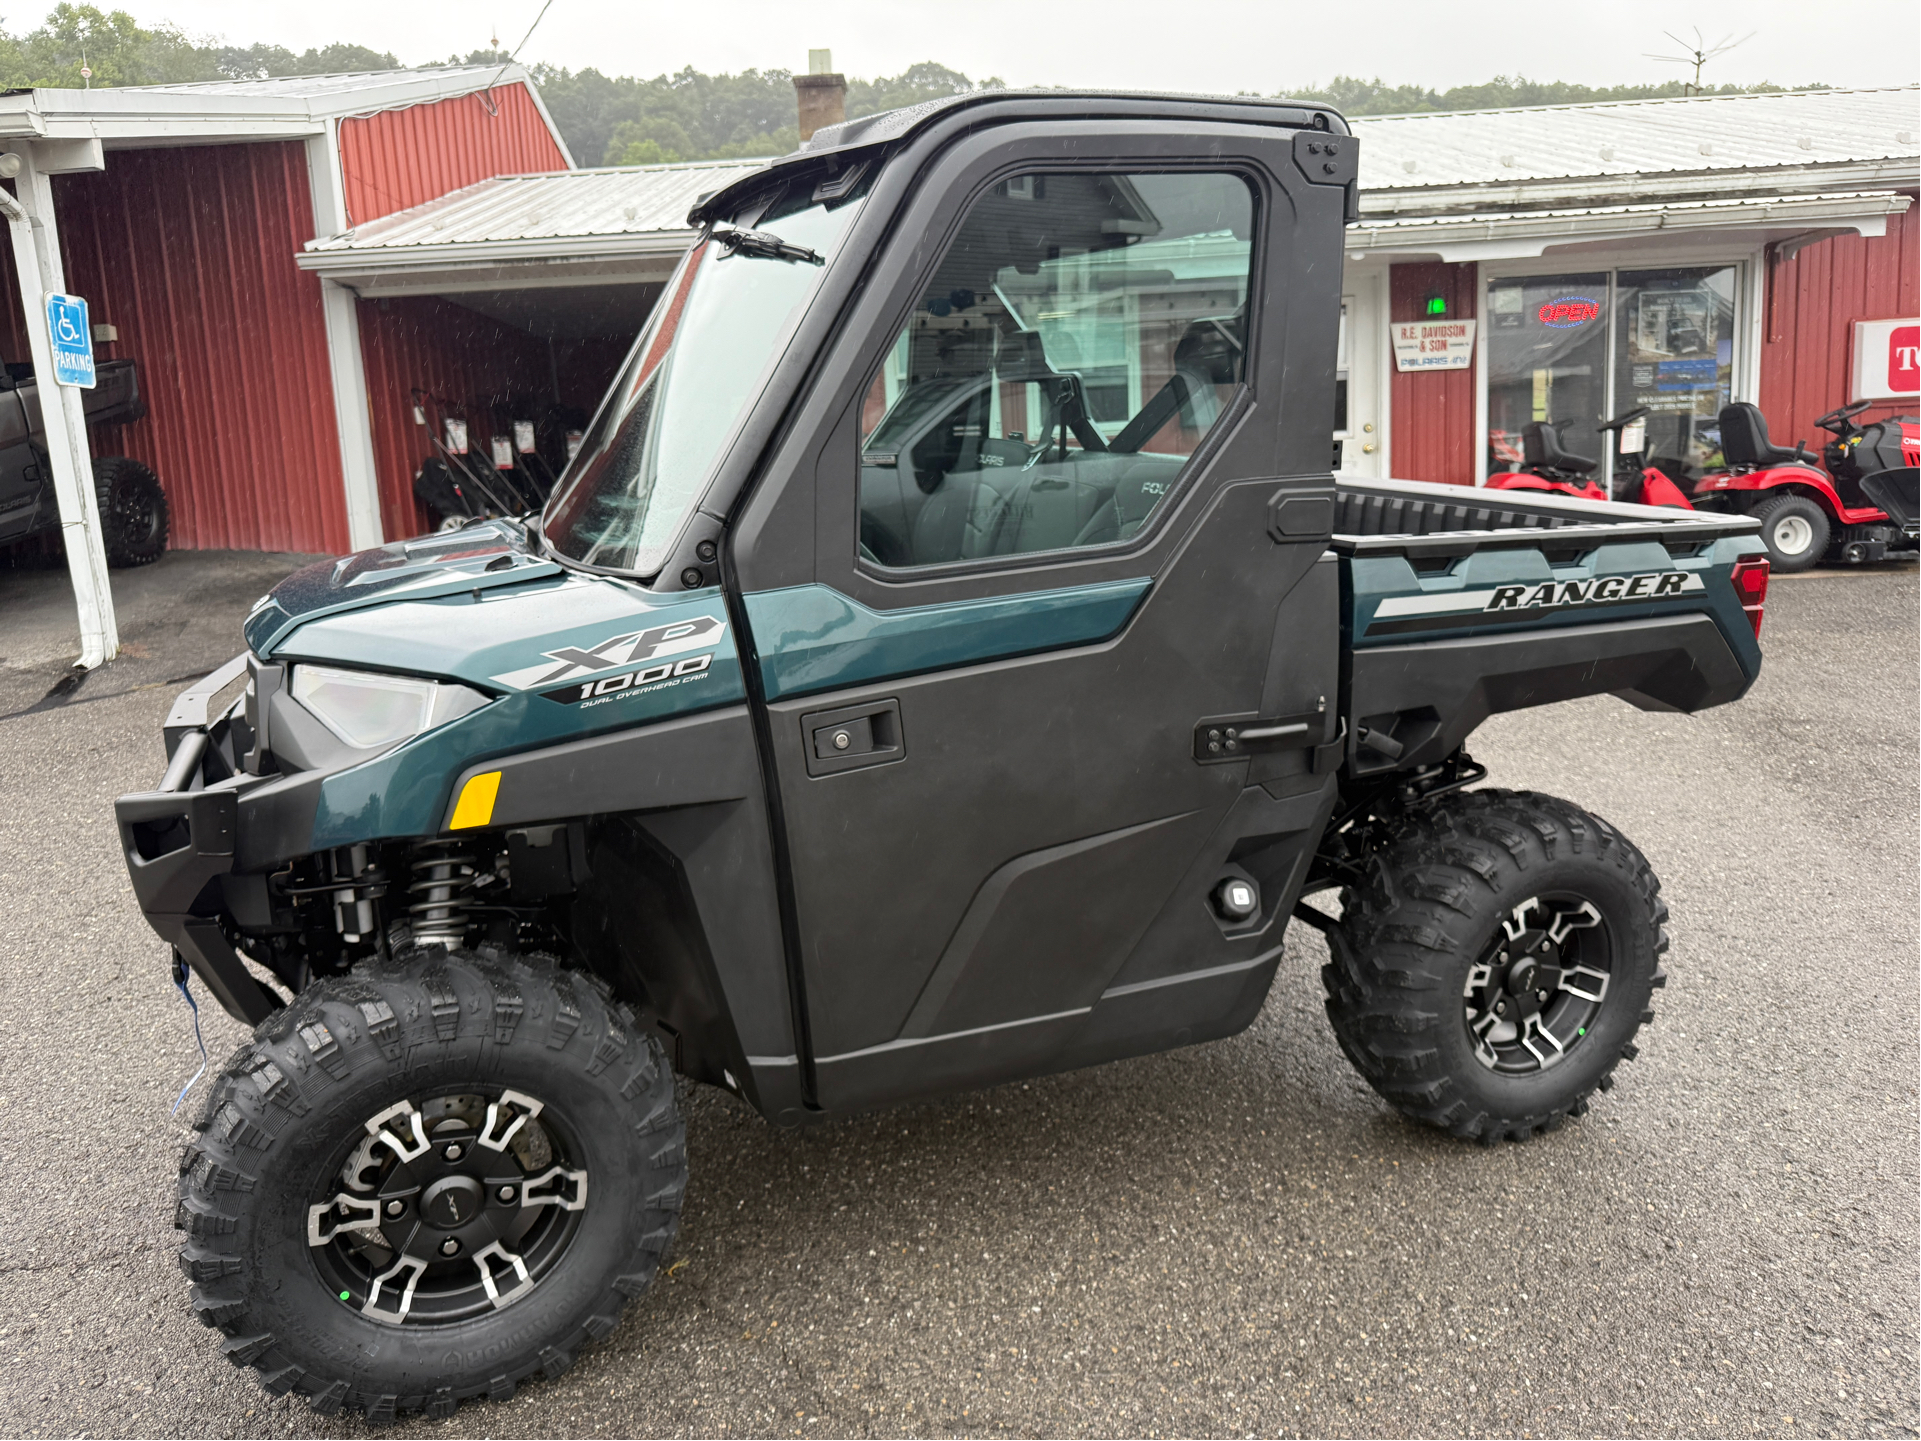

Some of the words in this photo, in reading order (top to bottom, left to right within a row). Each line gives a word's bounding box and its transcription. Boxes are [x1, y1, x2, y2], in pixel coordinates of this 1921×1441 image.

[1539, 303, 1599, 322] OPEN
[1401, 326, 1418, 340] R.E.
[1421, 324, 1466, 339] DAVIDSON
[1419, 340, 1426, 353] &
[1429, 339, 1448, 352] SON
[54, 351, 92, 372] PARKING
[1400, 357, 1448, 367] POLARIS
[1483, 571, 1689, 612] RANGER
[527, 615, 721, 687] XP
[580, 654, 712, 700] 1000
[580, 697, 614, 709] DUAL
[616, 679, 681, 700] OVERHEAD
[682, 672, 709, 684] CAM
[467, 1310, 553, 1369] ARMOR
